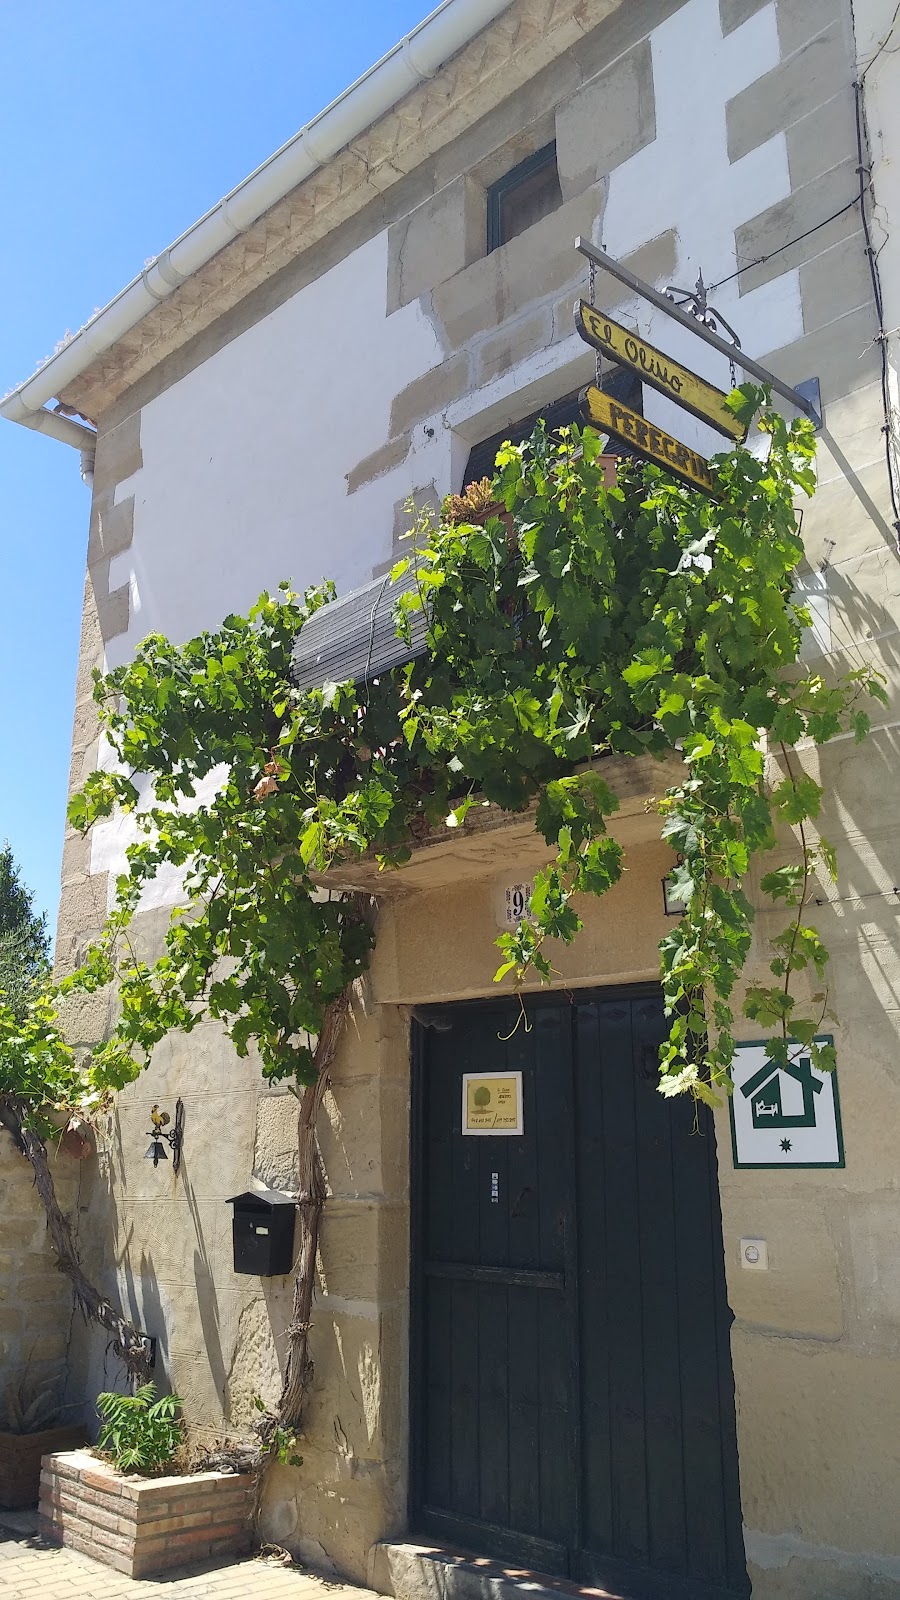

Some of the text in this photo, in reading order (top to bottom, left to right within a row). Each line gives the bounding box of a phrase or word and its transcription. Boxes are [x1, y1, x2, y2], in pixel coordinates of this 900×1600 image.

[589, 314, 683, 394] El Olivo
[513, 890, 524, 916] 9
